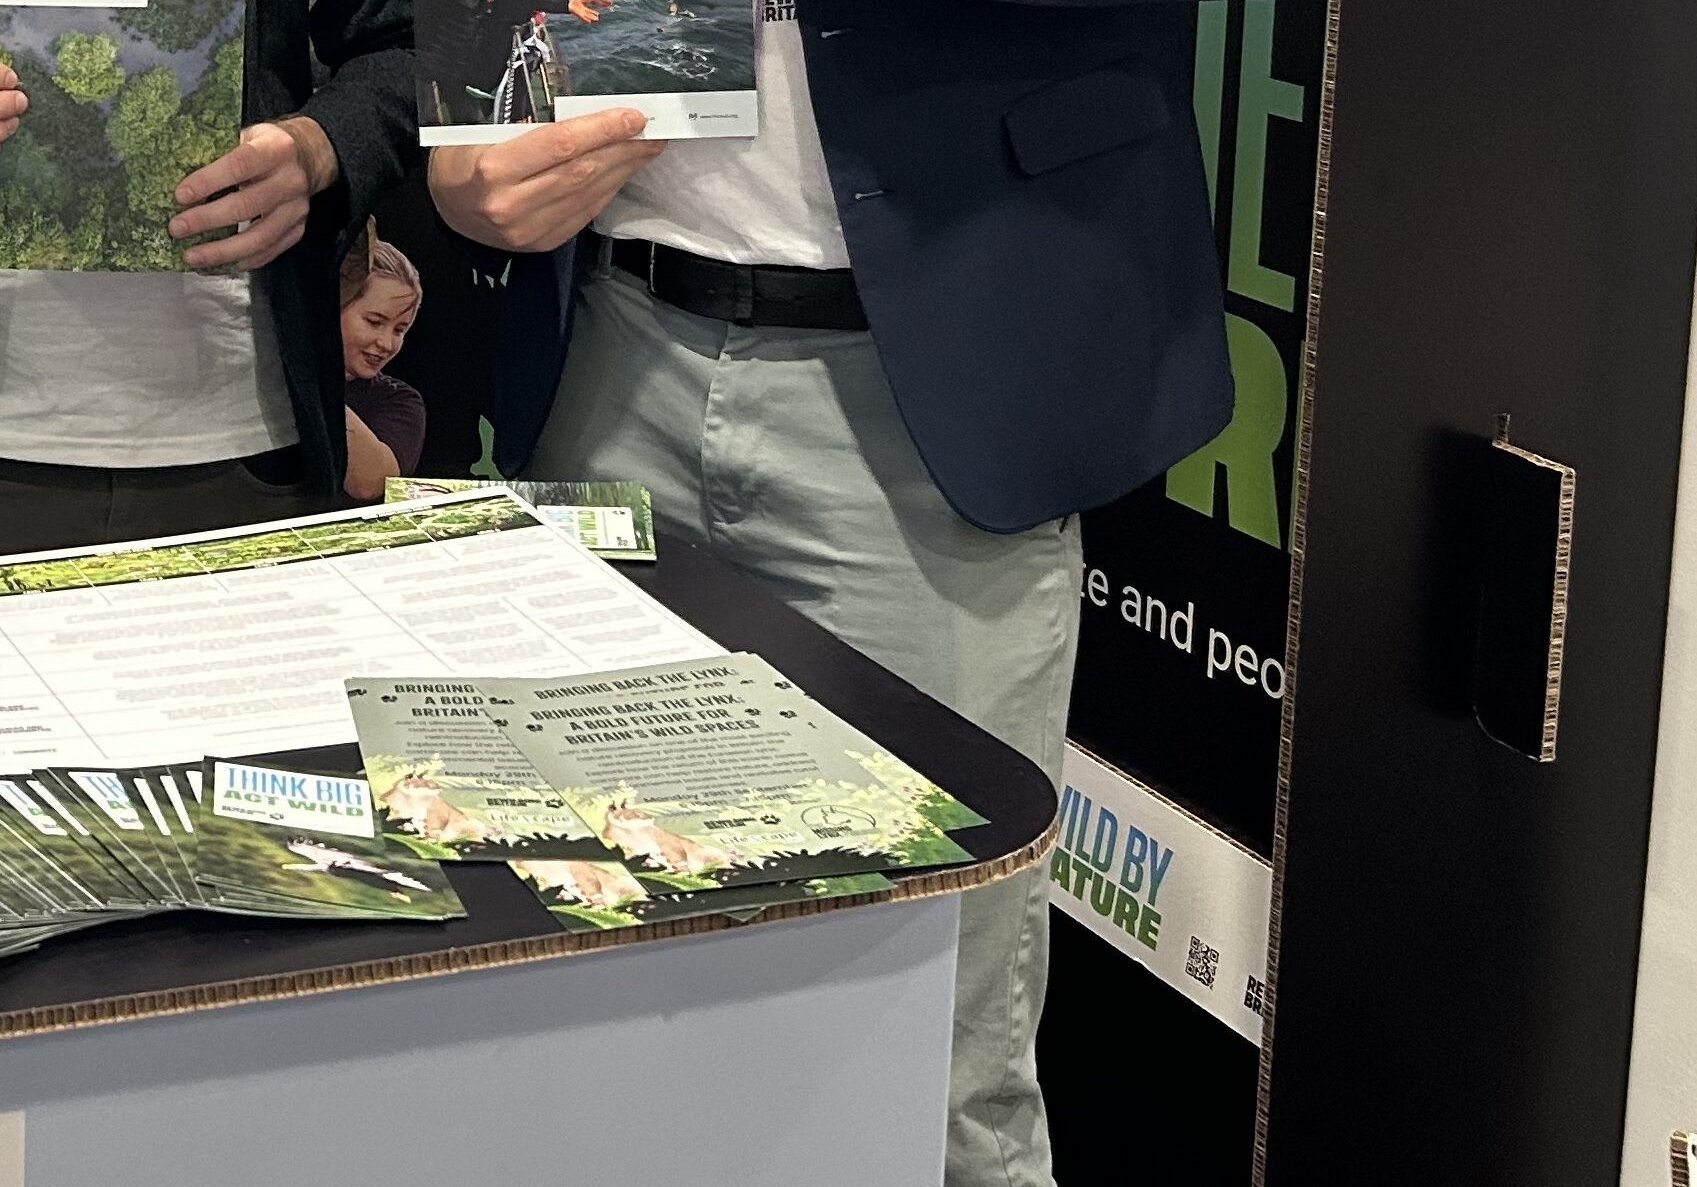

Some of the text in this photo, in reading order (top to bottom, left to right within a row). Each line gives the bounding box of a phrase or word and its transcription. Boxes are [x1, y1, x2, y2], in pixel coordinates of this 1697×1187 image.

[1120, 585, 1195, 654] and
[394, 684, 476, 694] BRINGING
[534, 681, 615, 701] BRINGING
[610, 675, 658, 692] BACK
[653, 671, 690, 686] THE
[424, 696, 484, 706] A BOLD
[529, 702, 615, 722] BRINGING
[611, 698, 659, 715] BACK
[655, 694, 696, 711] THE
[562, 728, 650, 745] BRITAIN'S
[647, 724, 695, 739] WILD
[693, 718, 761, 735] SPACES
[568, 707, 733, 732] A BOLD FUTURE FOR
[225, 767, 363, 806] THINK BIG
[223, 790, 280, 806] ACT
[287, 799, 365, 818] WILD
[1119, 824, 1175, 906] BY
